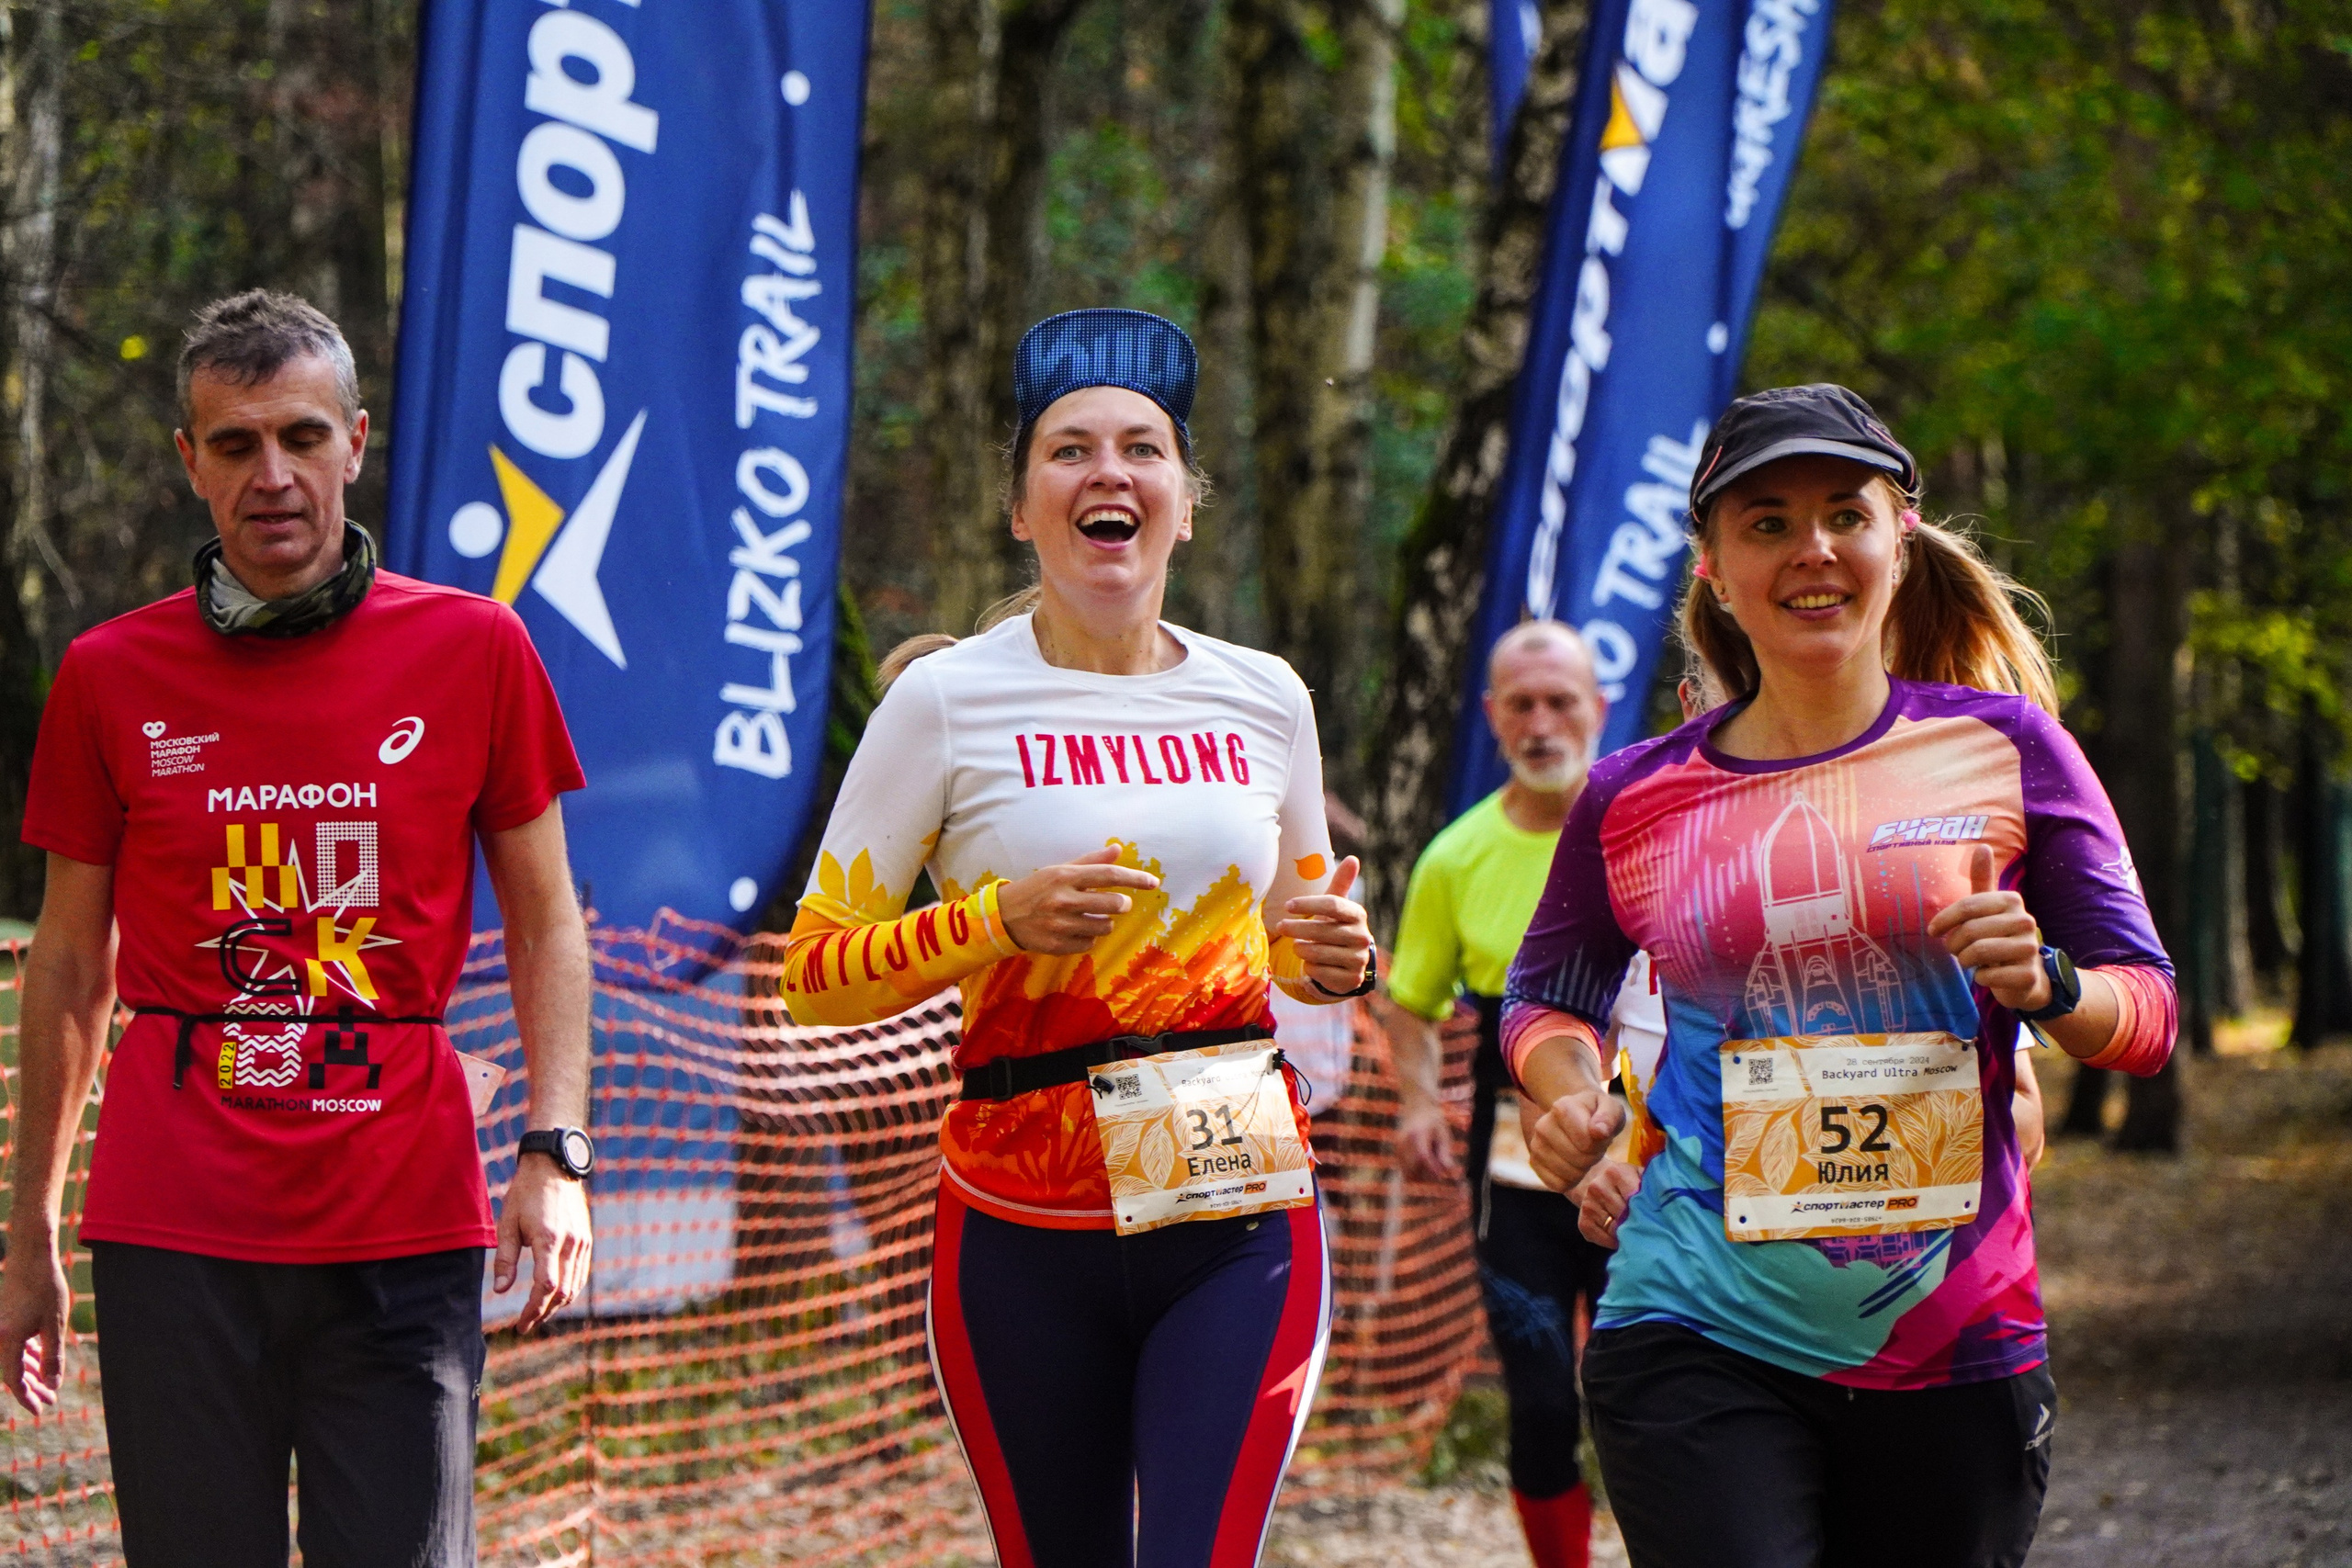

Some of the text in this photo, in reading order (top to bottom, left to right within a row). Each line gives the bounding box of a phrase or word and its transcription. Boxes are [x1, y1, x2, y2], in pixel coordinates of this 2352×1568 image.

[498, 0, 659, 459] спор
[713, 187, 821, 779] BLIZKO TRAIL
[1591, 418, 1711, 610] TRAIL
[150, 731, 220, 750] МОСКОВСКИЙ
[151, 745, 200, 759] МАРАФОН
[152, 755, 194, 768] MOSCOW
[152, 763, 205, 777] MARATHON
[1015, 731, 1250, 788] IZMYLONG
[208, 783, 377, 812] МАРАФОН
[220, 1043, 235, 1087] 2022
[1909, 1056, 1929, 1065] 2024
[1822, 1068, 1877, 1080] Backyard
[1884, 1067, 1917, 1077] Ultra
[220, 1096, 382, 1112] MARATHON MOSCOW
[1186, 1104, 1243, 1151] 31
[1820, 1104, 1891, 1154] 52
[1187, 1153, 1251, 1177] Елена
[1818, 1161, 1889, 1184] Юлия
[1245, 1182, 1266, 1193] PRO
[1888, 1198, 1917, 1209] PRO
